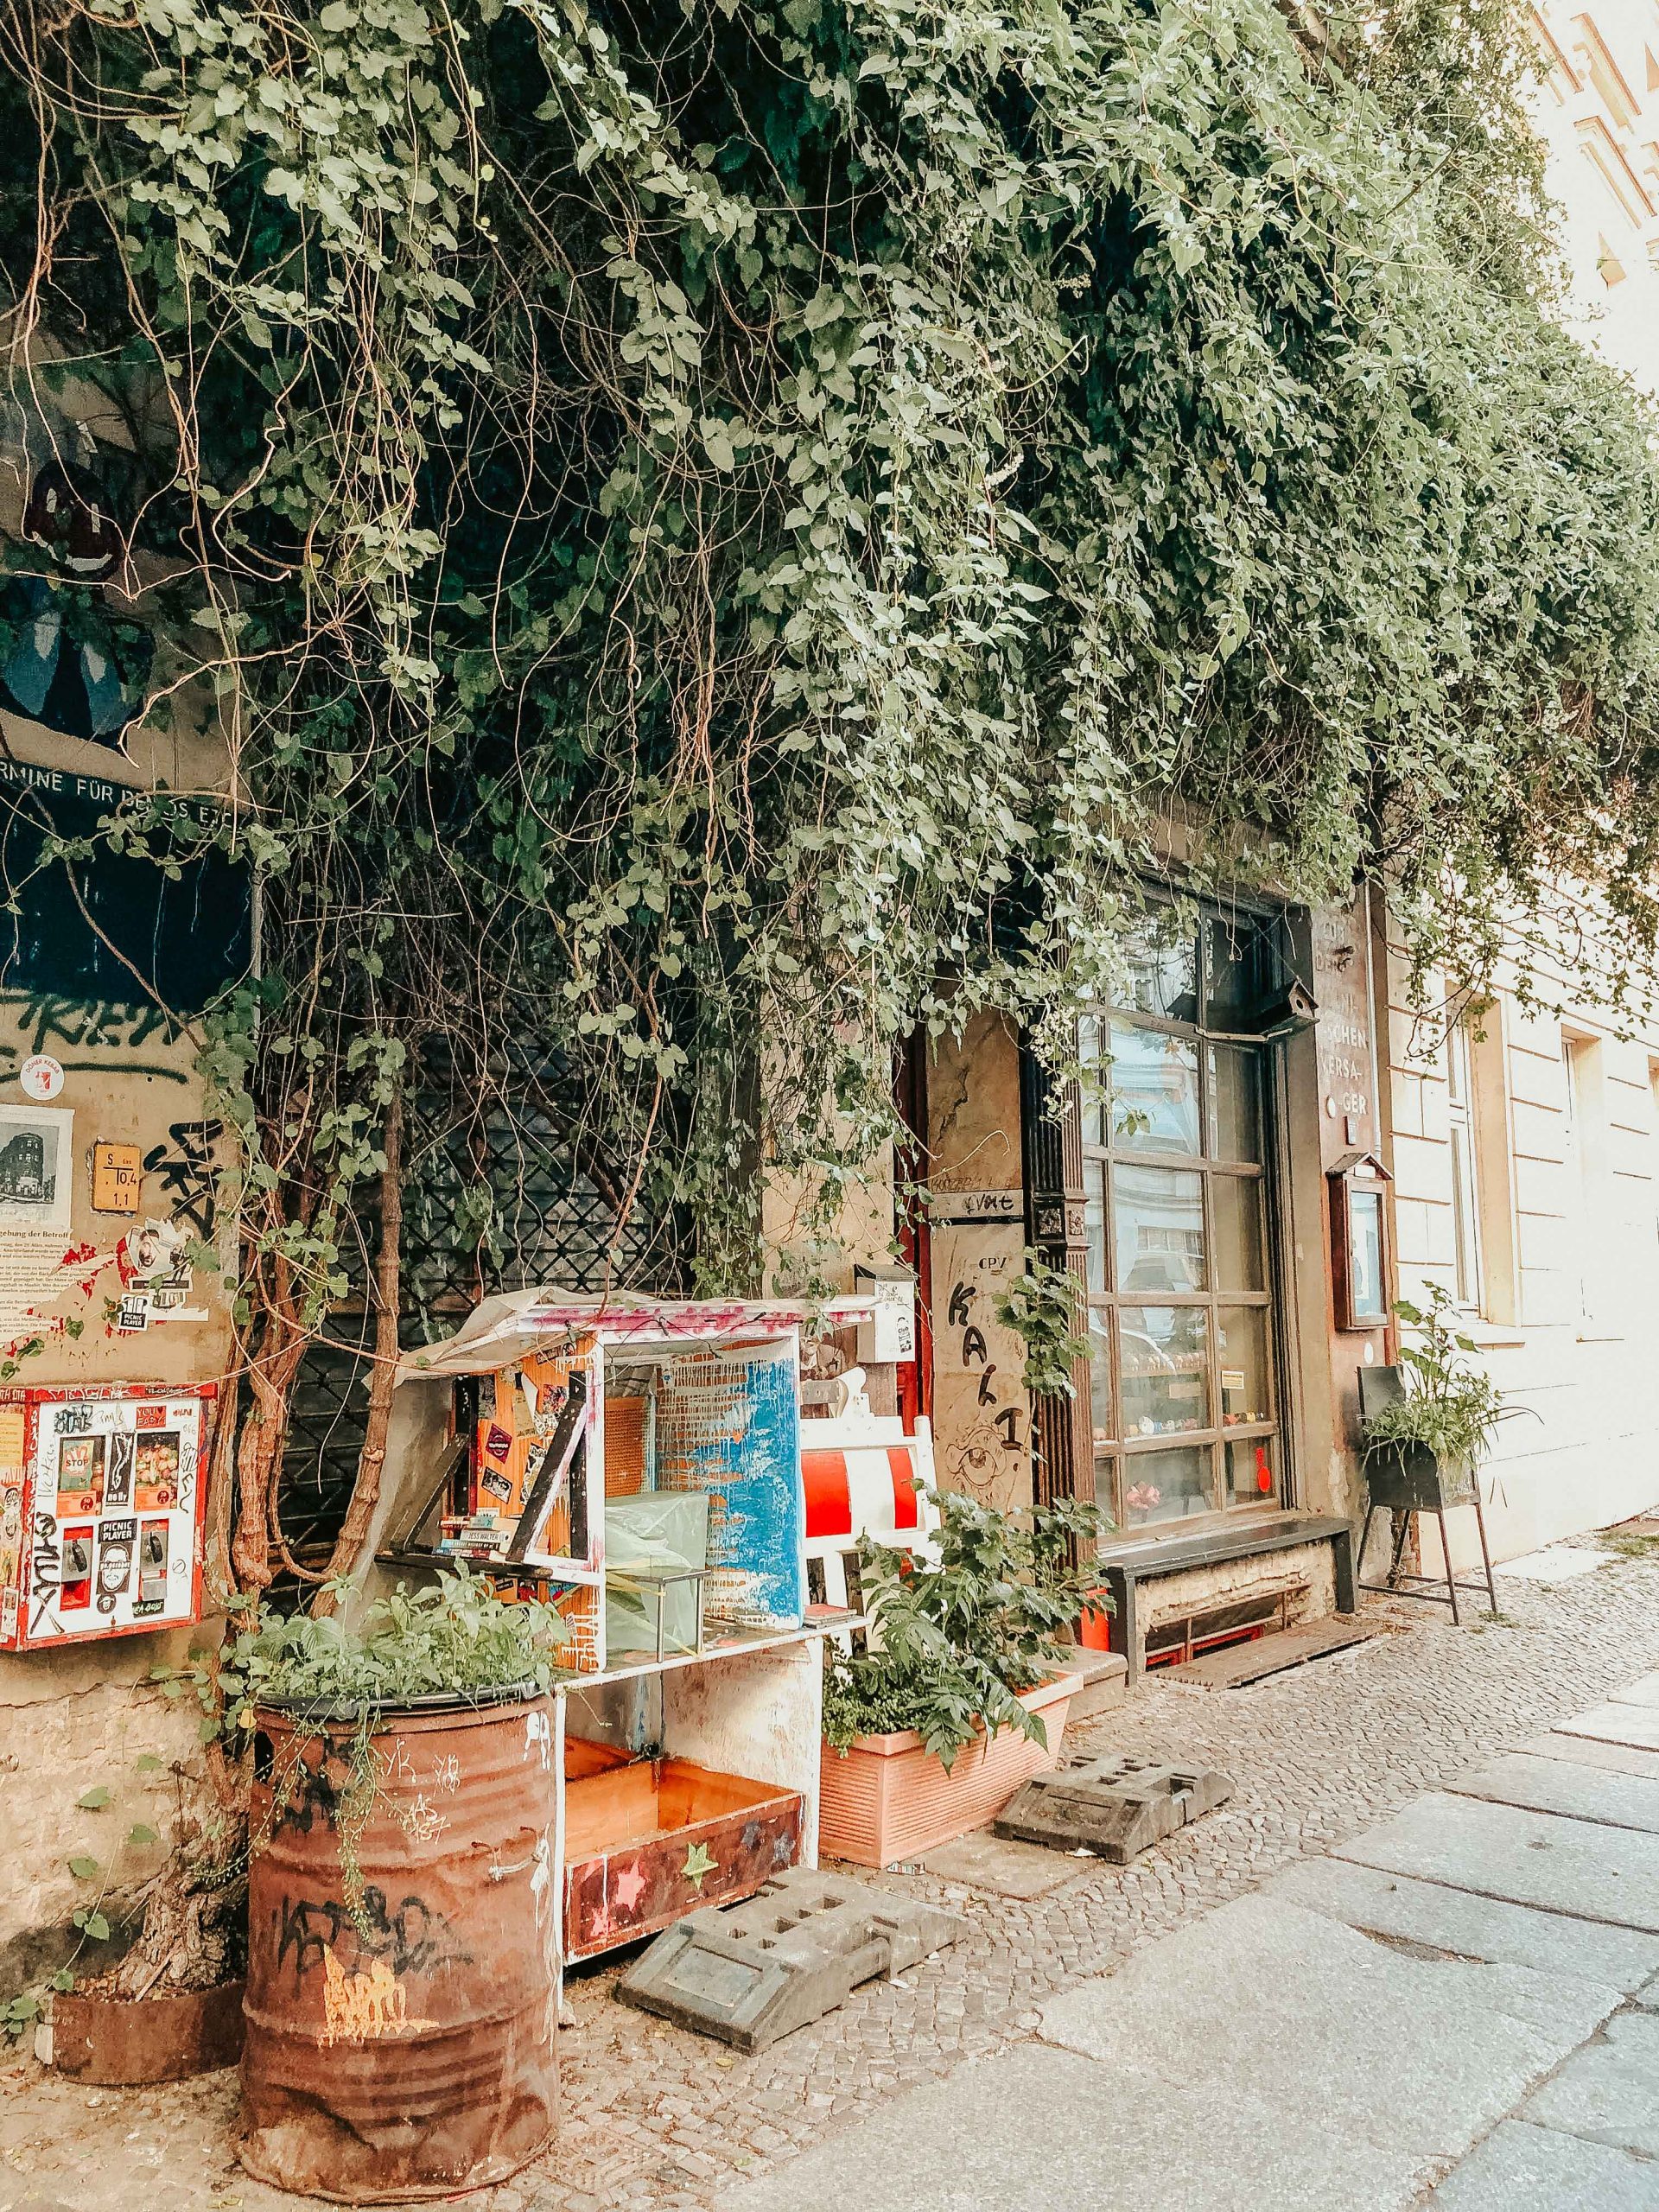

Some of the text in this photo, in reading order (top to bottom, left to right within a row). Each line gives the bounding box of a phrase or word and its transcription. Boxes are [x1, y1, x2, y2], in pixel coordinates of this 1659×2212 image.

[77, 779, 113, 803] FÜR
[108, 1154, 113, 1165] S
[103, 1521, 132, 1532] PICNIC
[103, 1530, 132, 1541] PLAYER
